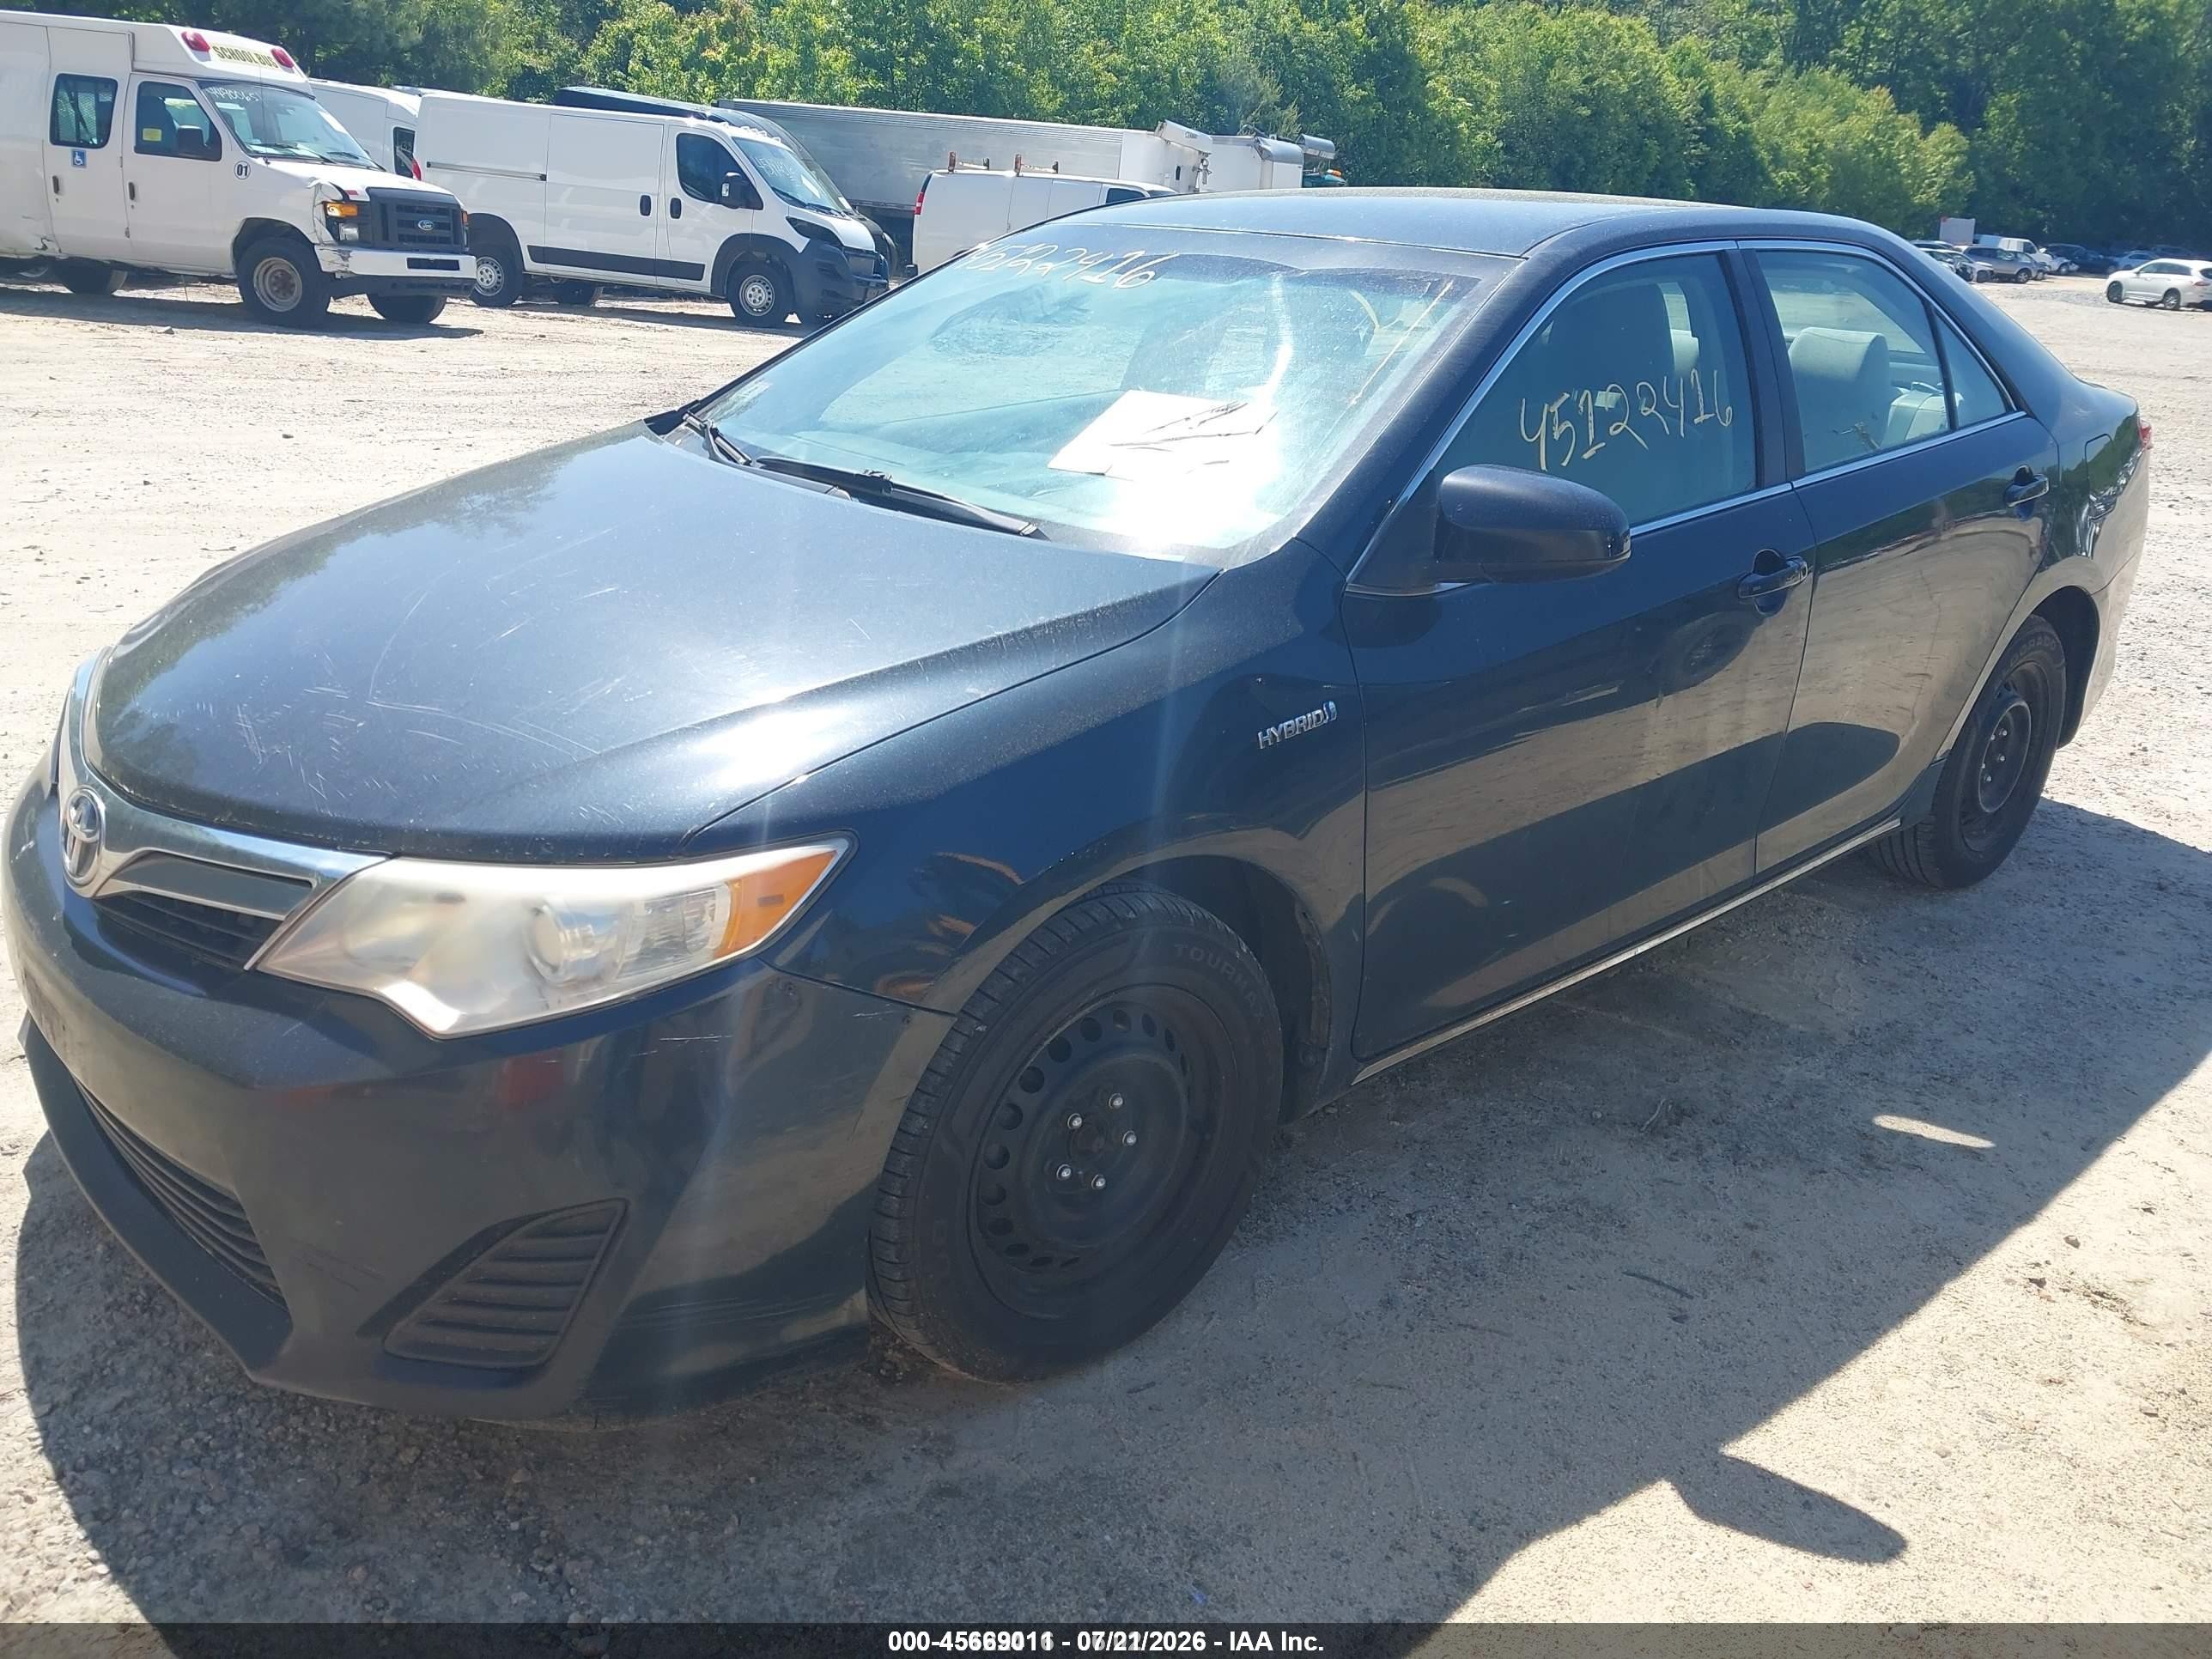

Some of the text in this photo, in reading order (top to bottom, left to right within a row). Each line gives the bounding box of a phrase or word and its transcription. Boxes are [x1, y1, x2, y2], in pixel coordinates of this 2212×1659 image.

[212, 46, 279, 69] SCHOOL BUS
[236, 163, 248, 176] 01
[1520, 368, 1733, 471] 45122416
[1257, 708, 1325, 750] HYBRID
